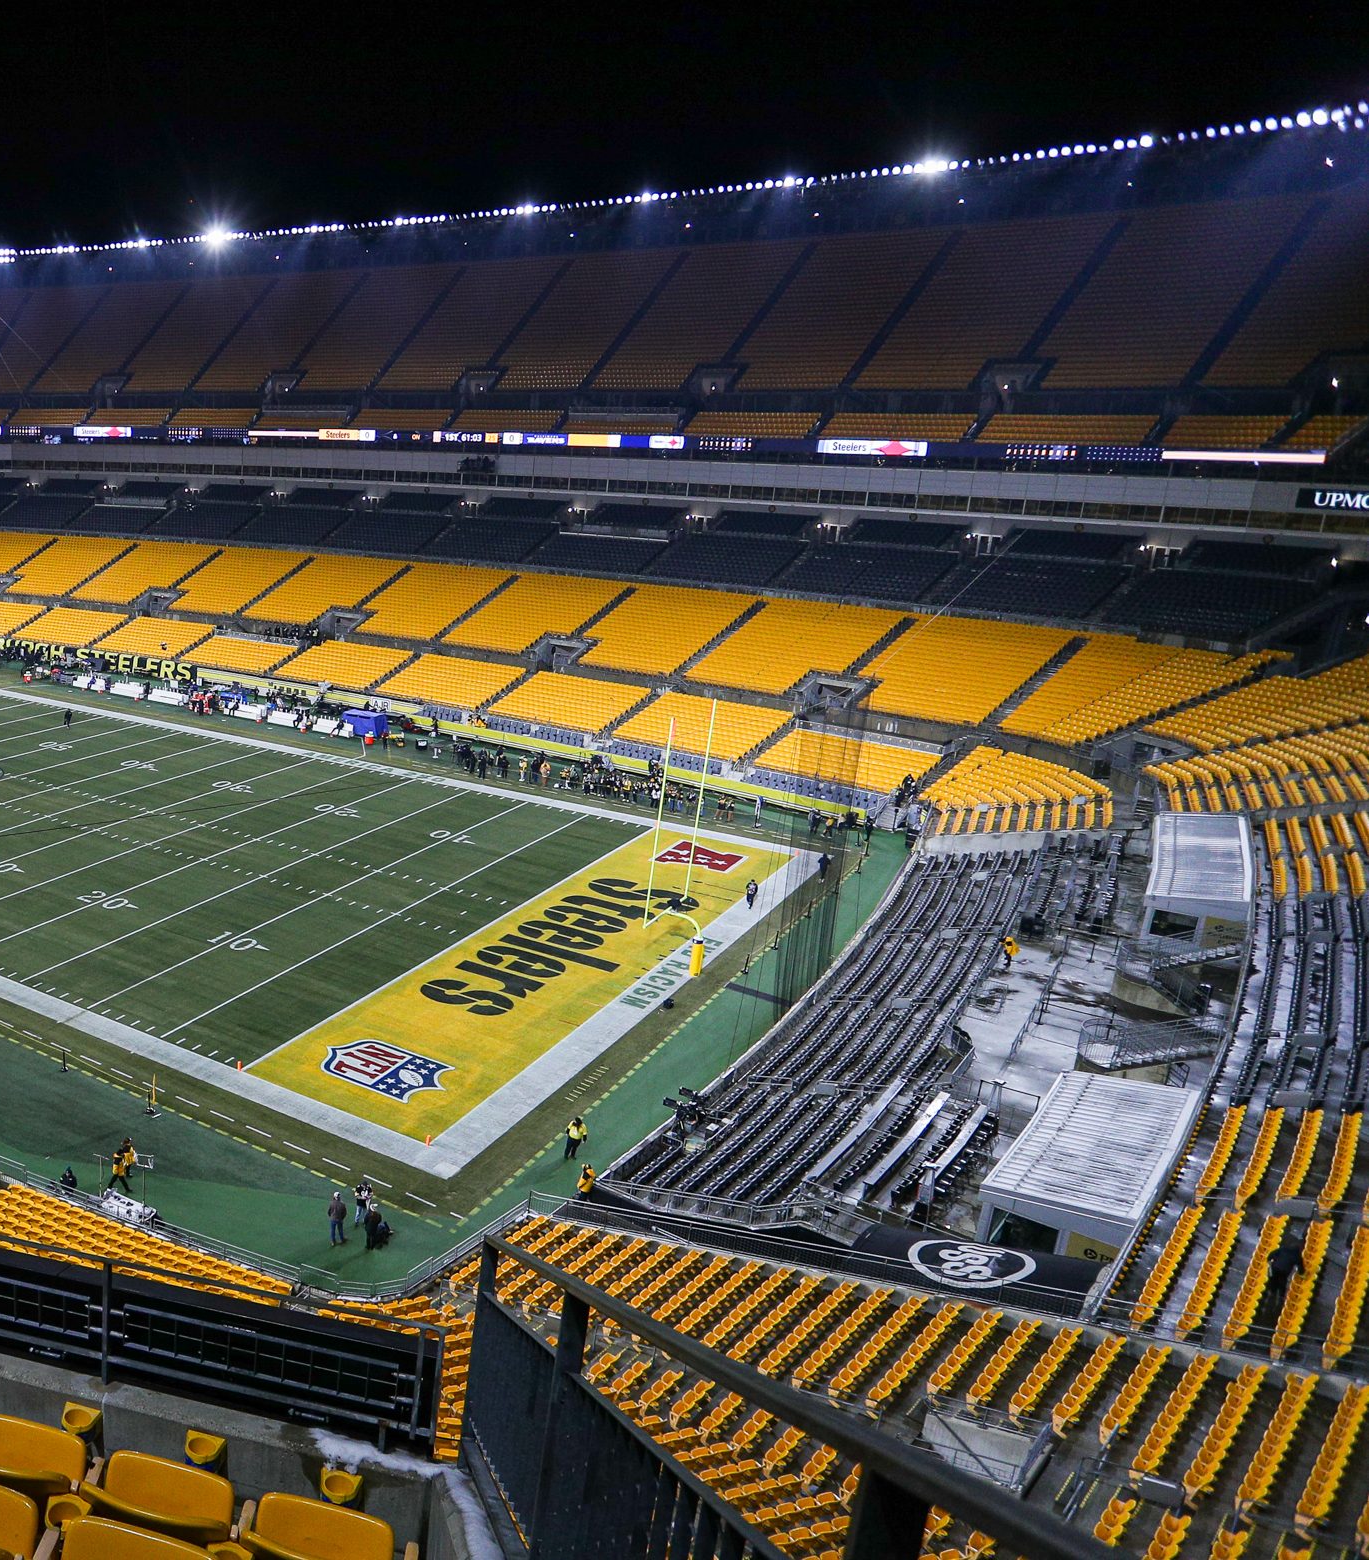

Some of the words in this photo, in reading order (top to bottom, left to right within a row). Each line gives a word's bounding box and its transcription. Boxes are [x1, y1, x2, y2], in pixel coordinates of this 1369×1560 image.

[325, 430, 350, 439] Steelers
[461, 434, 482, 442] 61:03
[832, 441, 867, 452] Steelers
[1314, 491, 1369, 509] UPMC
[313, 803, 358, 817] 20
[429, 829, 473, 845] 10
[76, 890, 129, 909] 20
[206, 931, 258, 950] 10
[419, 878, 700, 1016] Steelers
[620, 959, 690, 1010] RACISM
[333, 1044, 408, 1080] NFL
